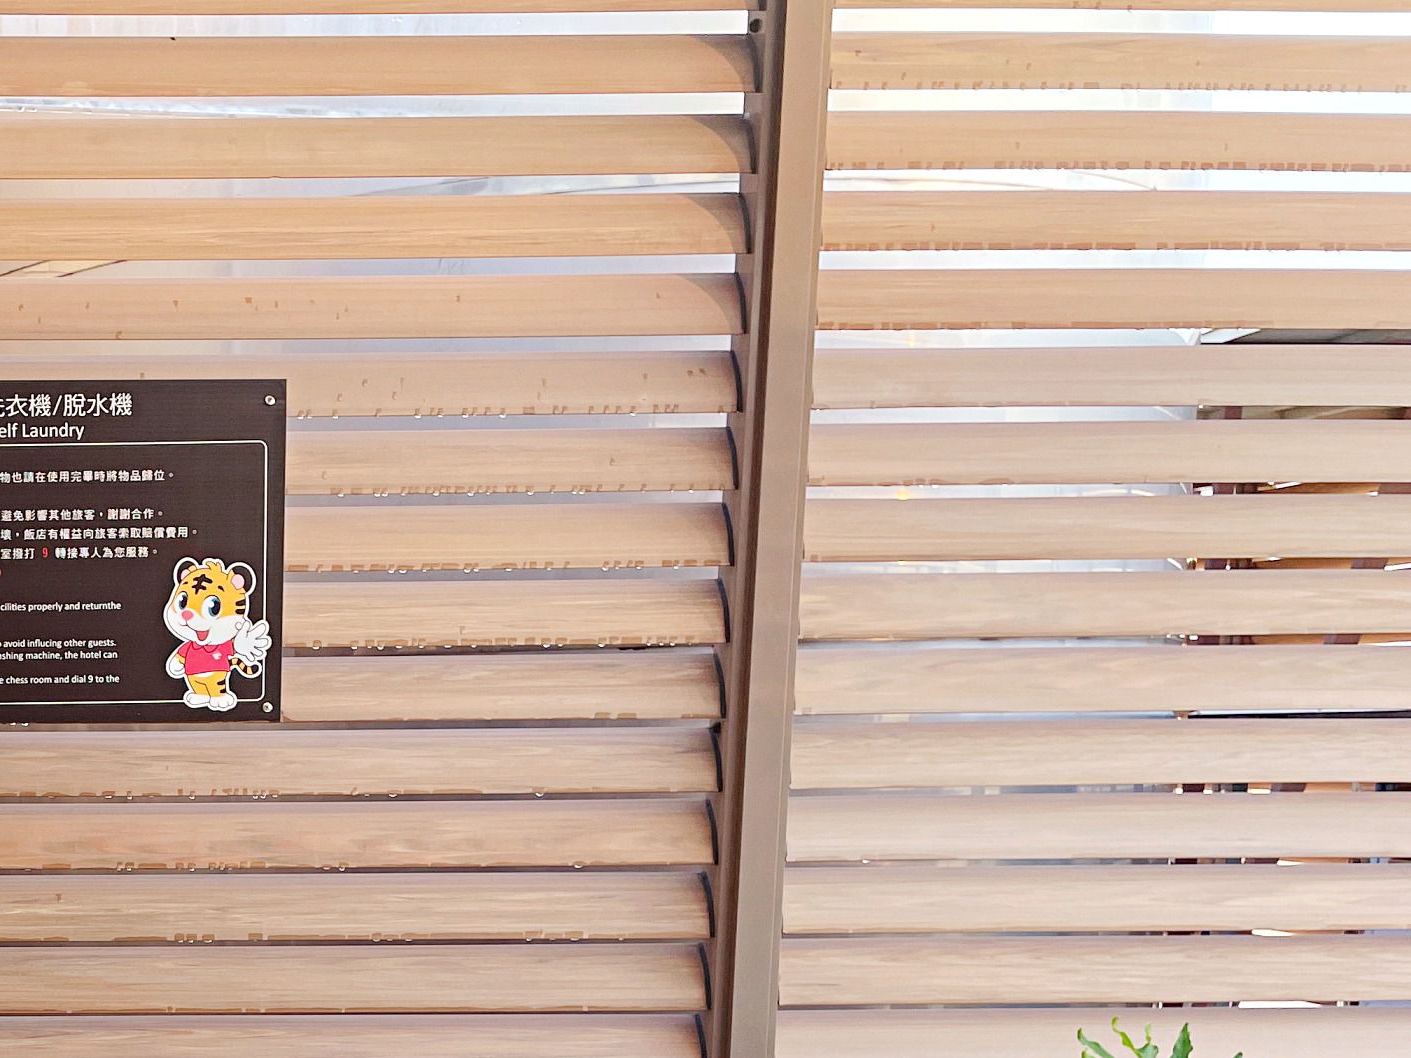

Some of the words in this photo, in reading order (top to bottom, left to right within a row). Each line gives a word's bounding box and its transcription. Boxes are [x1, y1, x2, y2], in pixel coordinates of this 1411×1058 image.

[22, 422, 85, 440] Laundry
[42, 547, 49, 558] 9
[28, 601, 63, 613] properly
[64, 601, 80, 611] and
[3, 639, 25, 648] avoid
[64, 638, 86, 648] other
[88, 638, 116, 650] guests.
[26, 650, 62, 661] machine,
[65, 650, 78, 660] the
[80, 649, 101, 659] hotel
[103, 651, 118, 659] can
[6, 675, 28, 685] chess
[30, 676, 52, 684] room
[54, 674, 69, 684] and
[71, 674, 86, 684] dial
[88, 674, 93, 684] 9
[95, 675, 104, 684] to
[106, 674, 119, 683] the
